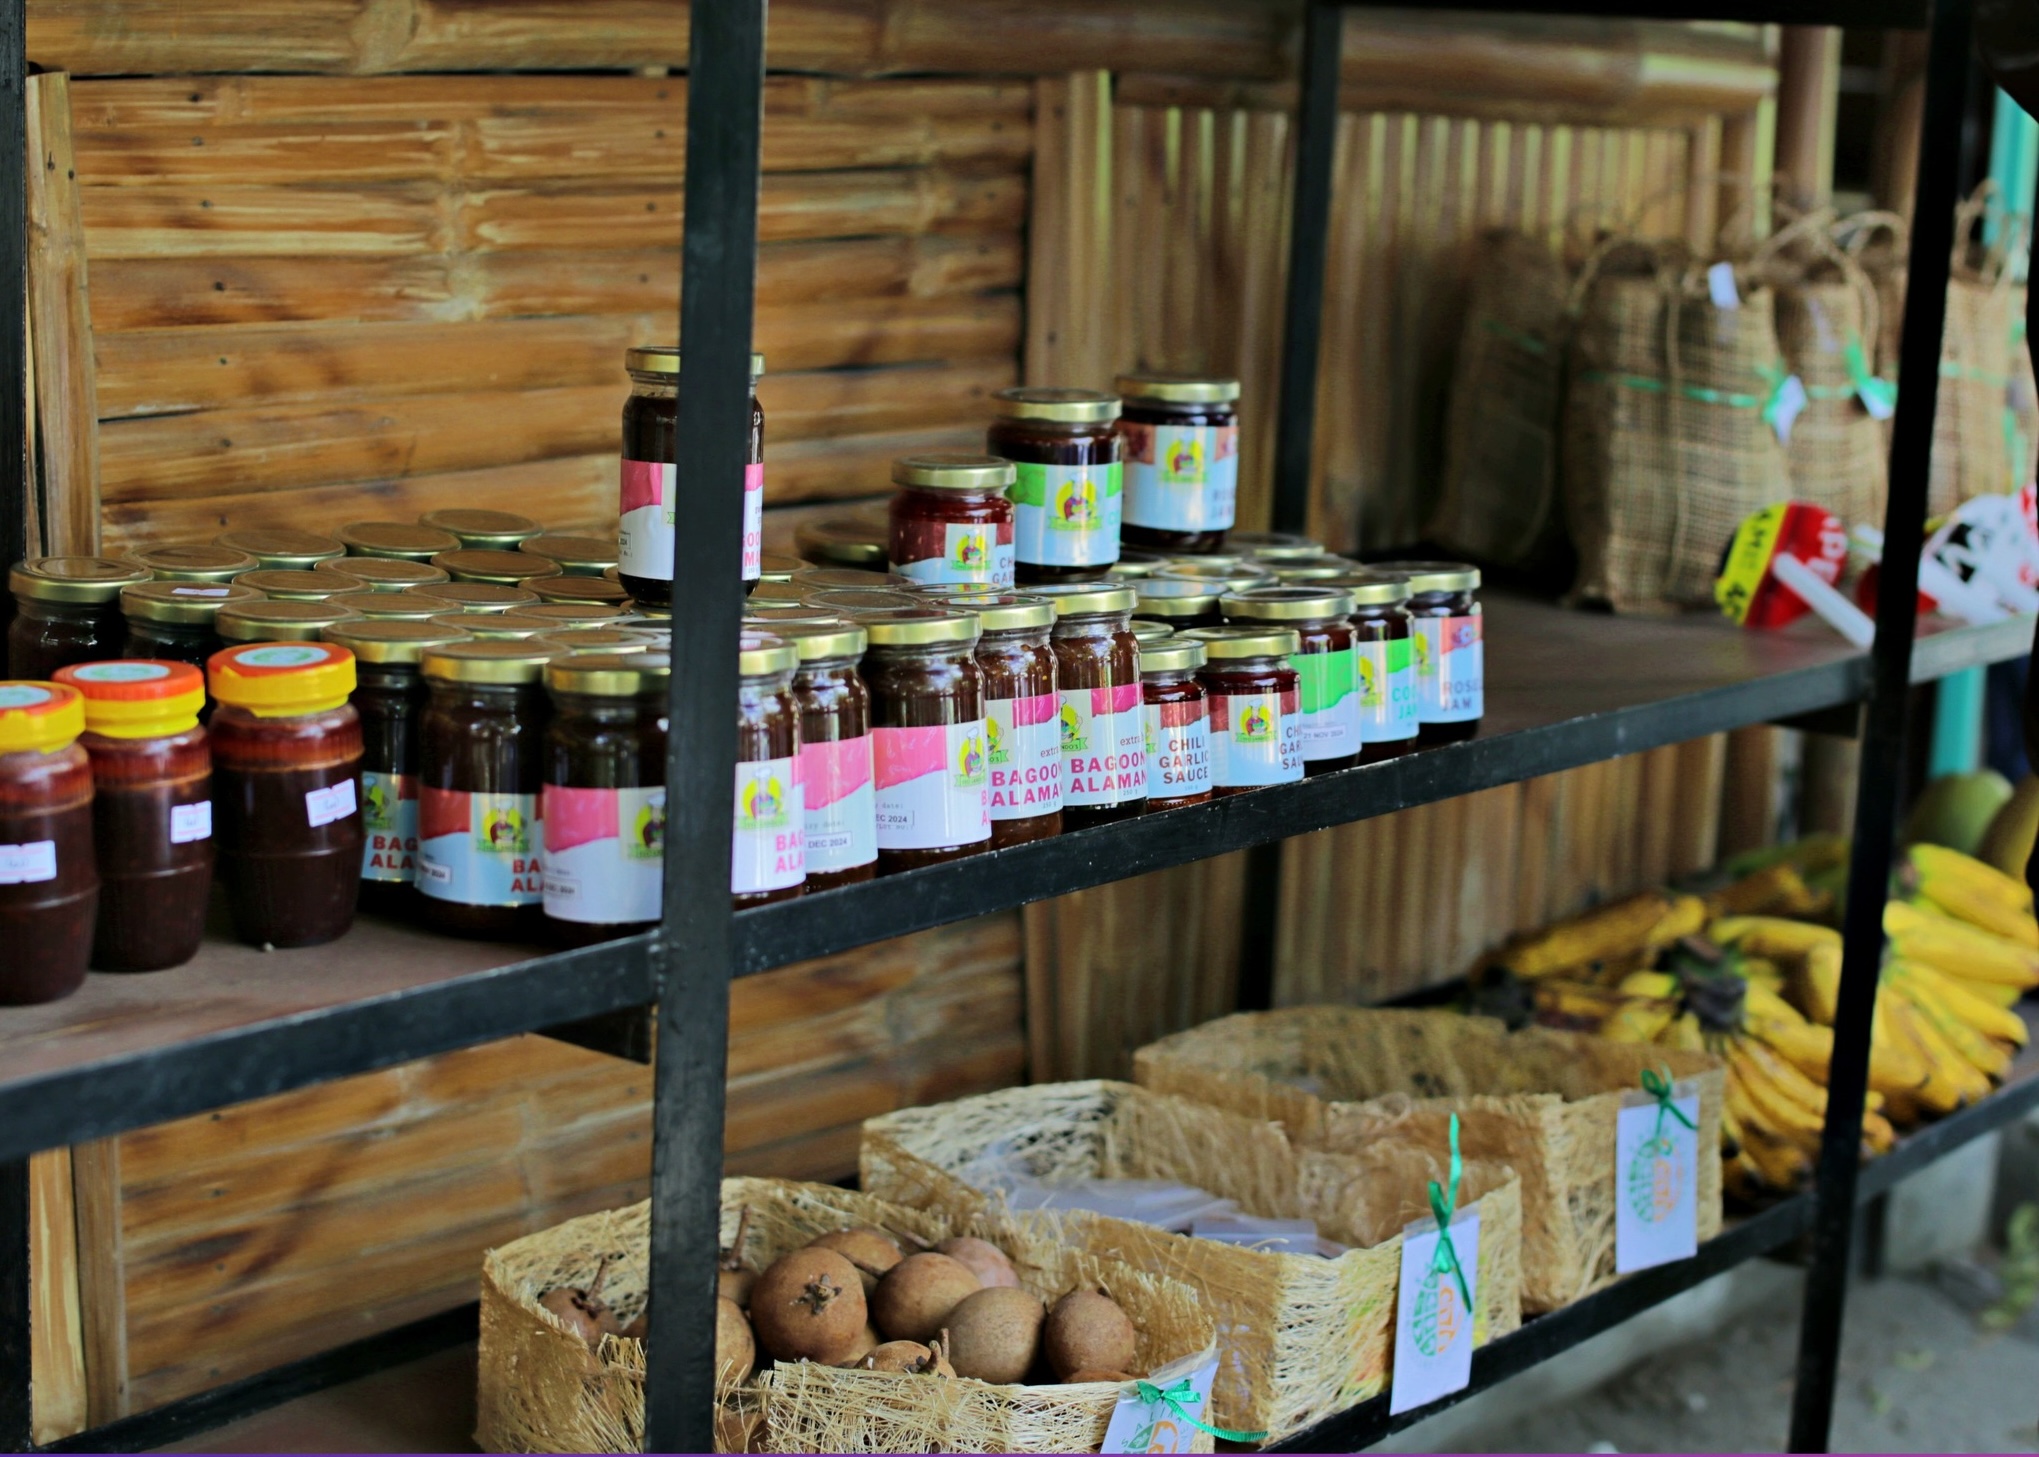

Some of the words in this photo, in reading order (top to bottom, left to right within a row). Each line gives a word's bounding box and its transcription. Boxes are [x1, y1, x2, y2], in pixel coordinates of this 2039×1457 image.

[1119, 735, 1141, 746] extra
[1158, 751, 1209, 769] GARLIC
[1163, 766, 1209, 784] SAUCE
[888, 814, 908, 824] 2024
[808, 839, 828, 849] DEC
[829, 837, 848, 848] 2024
